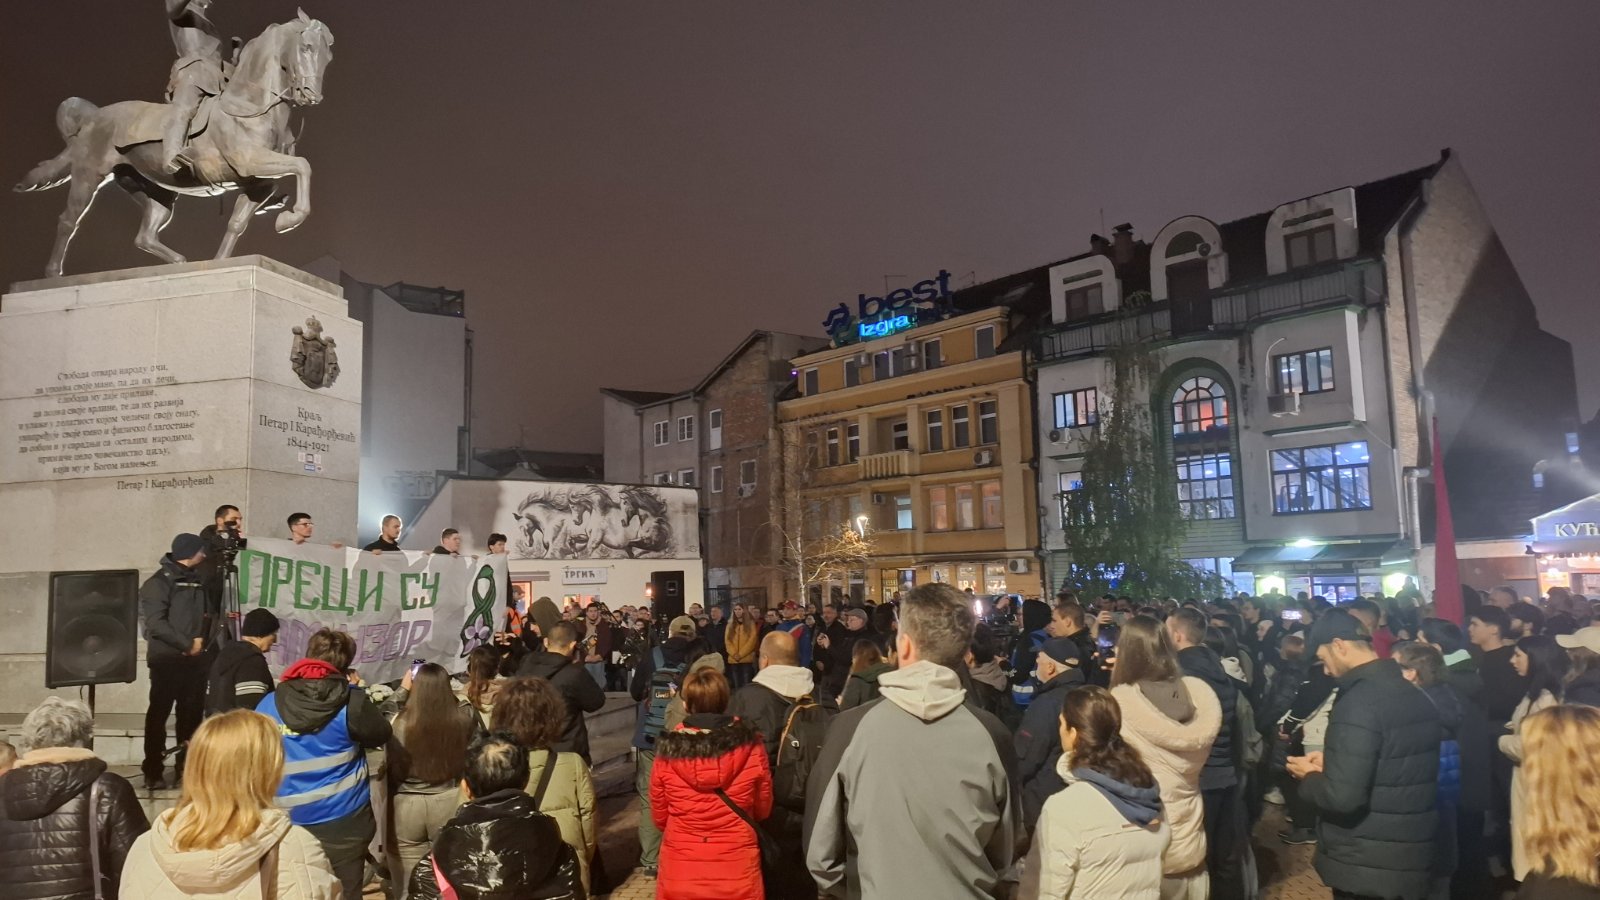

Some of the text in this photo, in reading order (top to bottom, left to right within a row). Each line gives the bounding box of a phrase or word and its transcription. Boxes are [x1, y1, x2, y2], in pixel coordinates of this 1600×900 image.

[858, 269, 951, 318] best
[119, 366, 147, 376] народу
[153, 398, 184, 409] развија
[154, 410, 173, 420] своју
[297, 406, 322, 422] Краљ
[259, 414, 288, 432] Петар
[296, 421, 356, 442] Карађорђевић
[287, 436, 330, 452] 1844-1921
[82, 464, 90, 474] је
[93, 462, 118, 472] Богом
[117, 480, 143, 491] Петар
[151, 474, 215, 489] Карађорђевић
[565, 570, 596, 579] ТРГИЋ
[240, 549, 440, 617] ПРЕЦИ СУ
